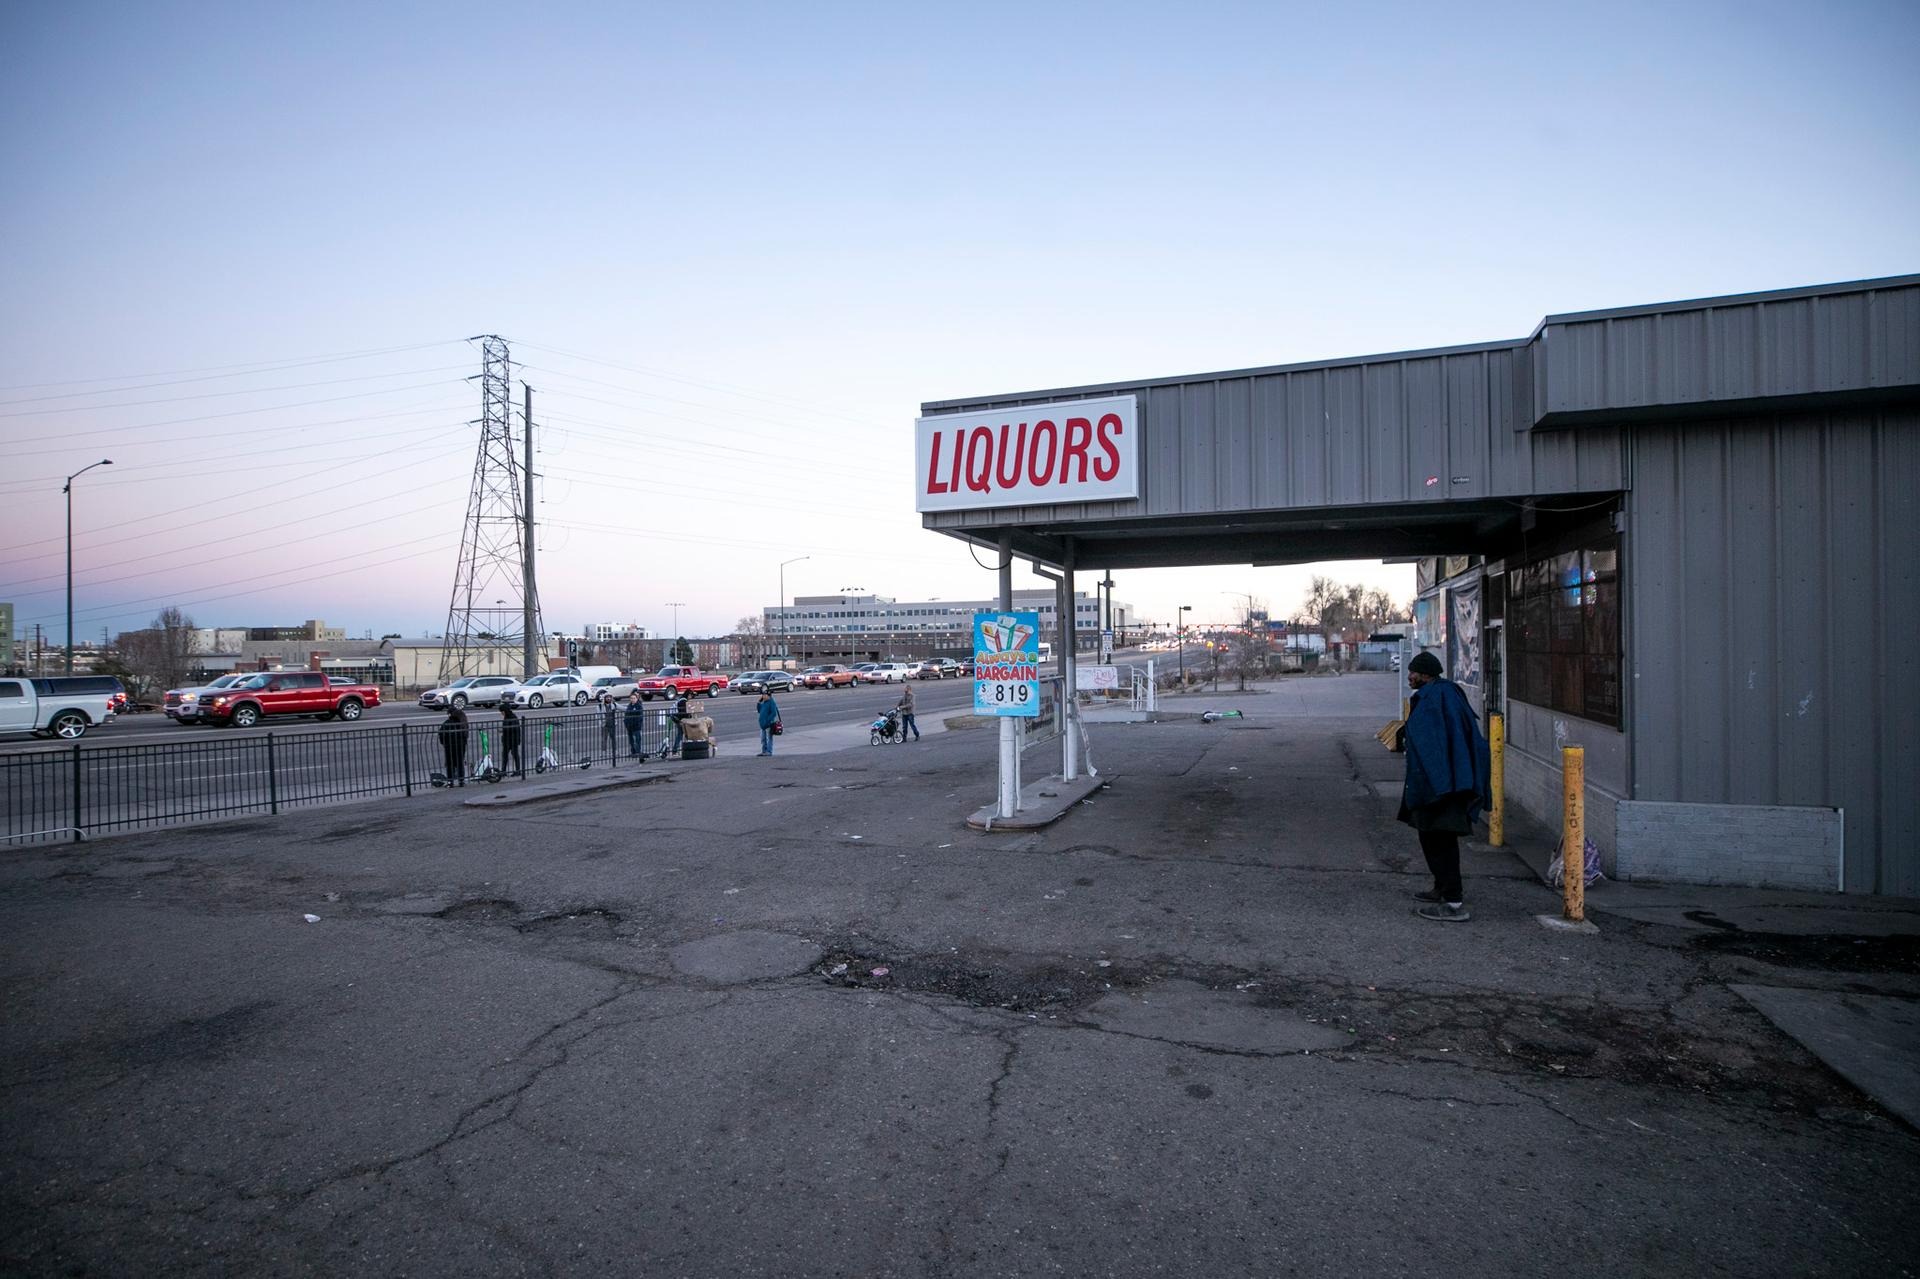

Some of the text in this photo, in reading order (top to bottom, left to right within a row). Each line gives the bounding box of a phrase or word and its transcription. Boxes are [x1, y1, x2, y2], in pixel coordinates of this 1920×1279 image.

[927, 412, 1123, 494] LIQUORS
[975, 650, 1027, 665] Always
[976, 665, 1037, 681] BARGAIN
